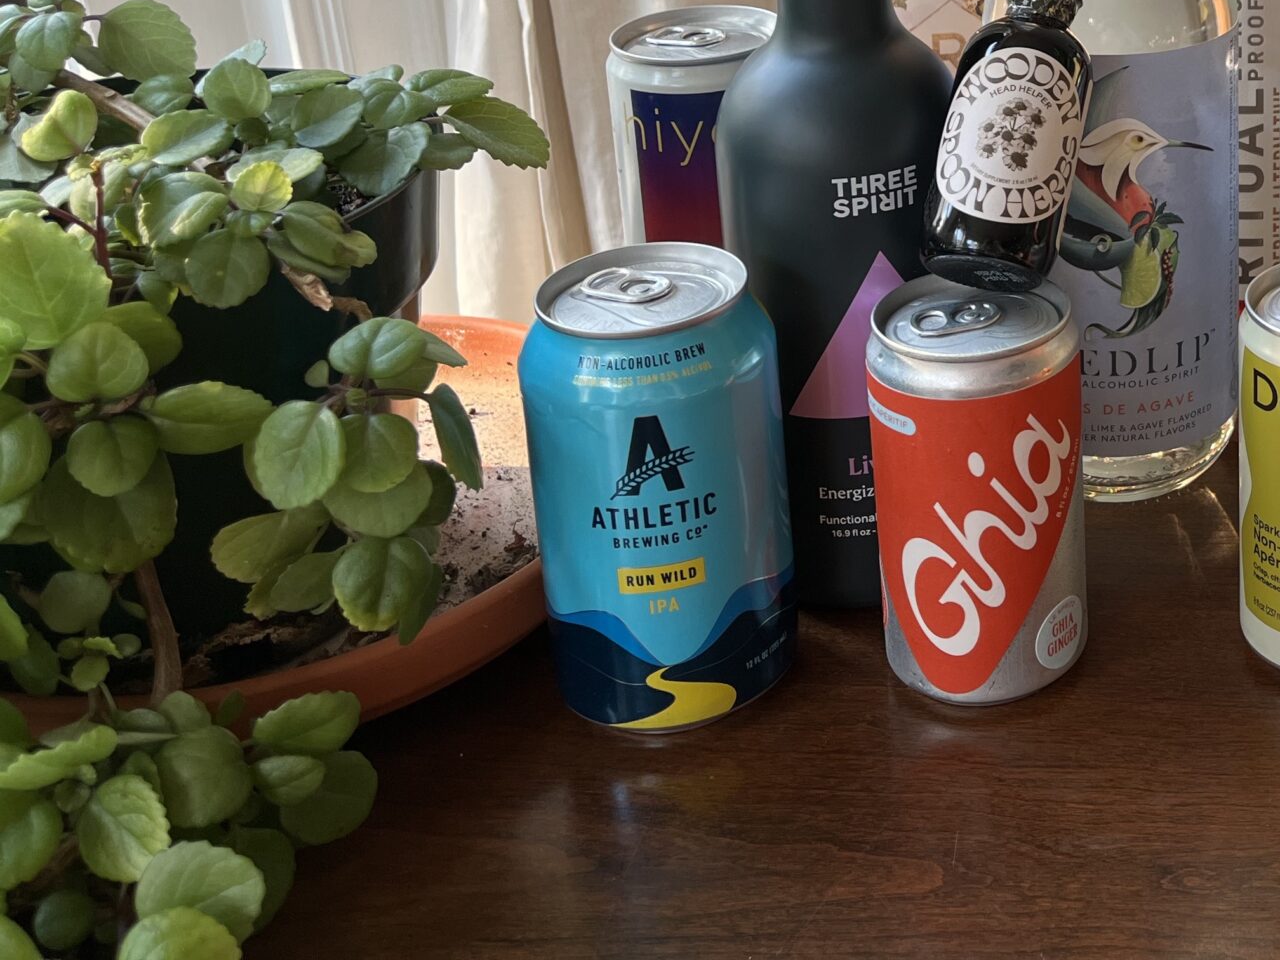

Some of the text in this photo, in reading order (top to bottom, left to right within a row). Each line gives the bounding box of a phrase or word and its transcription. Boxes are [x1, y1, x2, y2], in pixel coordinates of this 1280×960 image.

[957, 52, 1080, 125] WOODEN
[989, 84, 1053, 110] HEAD HELPER
[831, 164, 918, 198] THREE
[999, 135, 1078, 219] HERBS
[1237, 88, 1265, 285] RITUAL
[832, 184, 918, 218] SPIRIT
[576, 341, 706, 372] NON-ALCOHOLIC BREW
[1079, 328, 1206, 378] EDLIP
[1082, 365, 1201, 390] ALCOHOLIC SPIRIT
[1090, 423, 1119, 433] LIME
[1129, 420, 1164, 432] AGAVE
[1167, 403, 1213, 426] FLAVORED
[1102, 402, 1127, 416] DE
[1136, 390, 1197, 415] AGAVE
[1101, 432, 1151, 442] NATURAL
[1154, 421, 1197, 439] FLAVORS
[819, 485, 876, 502] Energiz
[590, 491, 718, 530] ATHLETIC
[612, 532, 681, 550] BREWING
[832, 529, 850, 538] 16.9
[901, 411, 1073, 657] Ghia
[625, 566, 699, 588] RUN WILD
[648, 596, 681, 615] IPA
[1047, 622, 1078, 657] GINGER
[1052, 611, 1075, 638] GHIA
